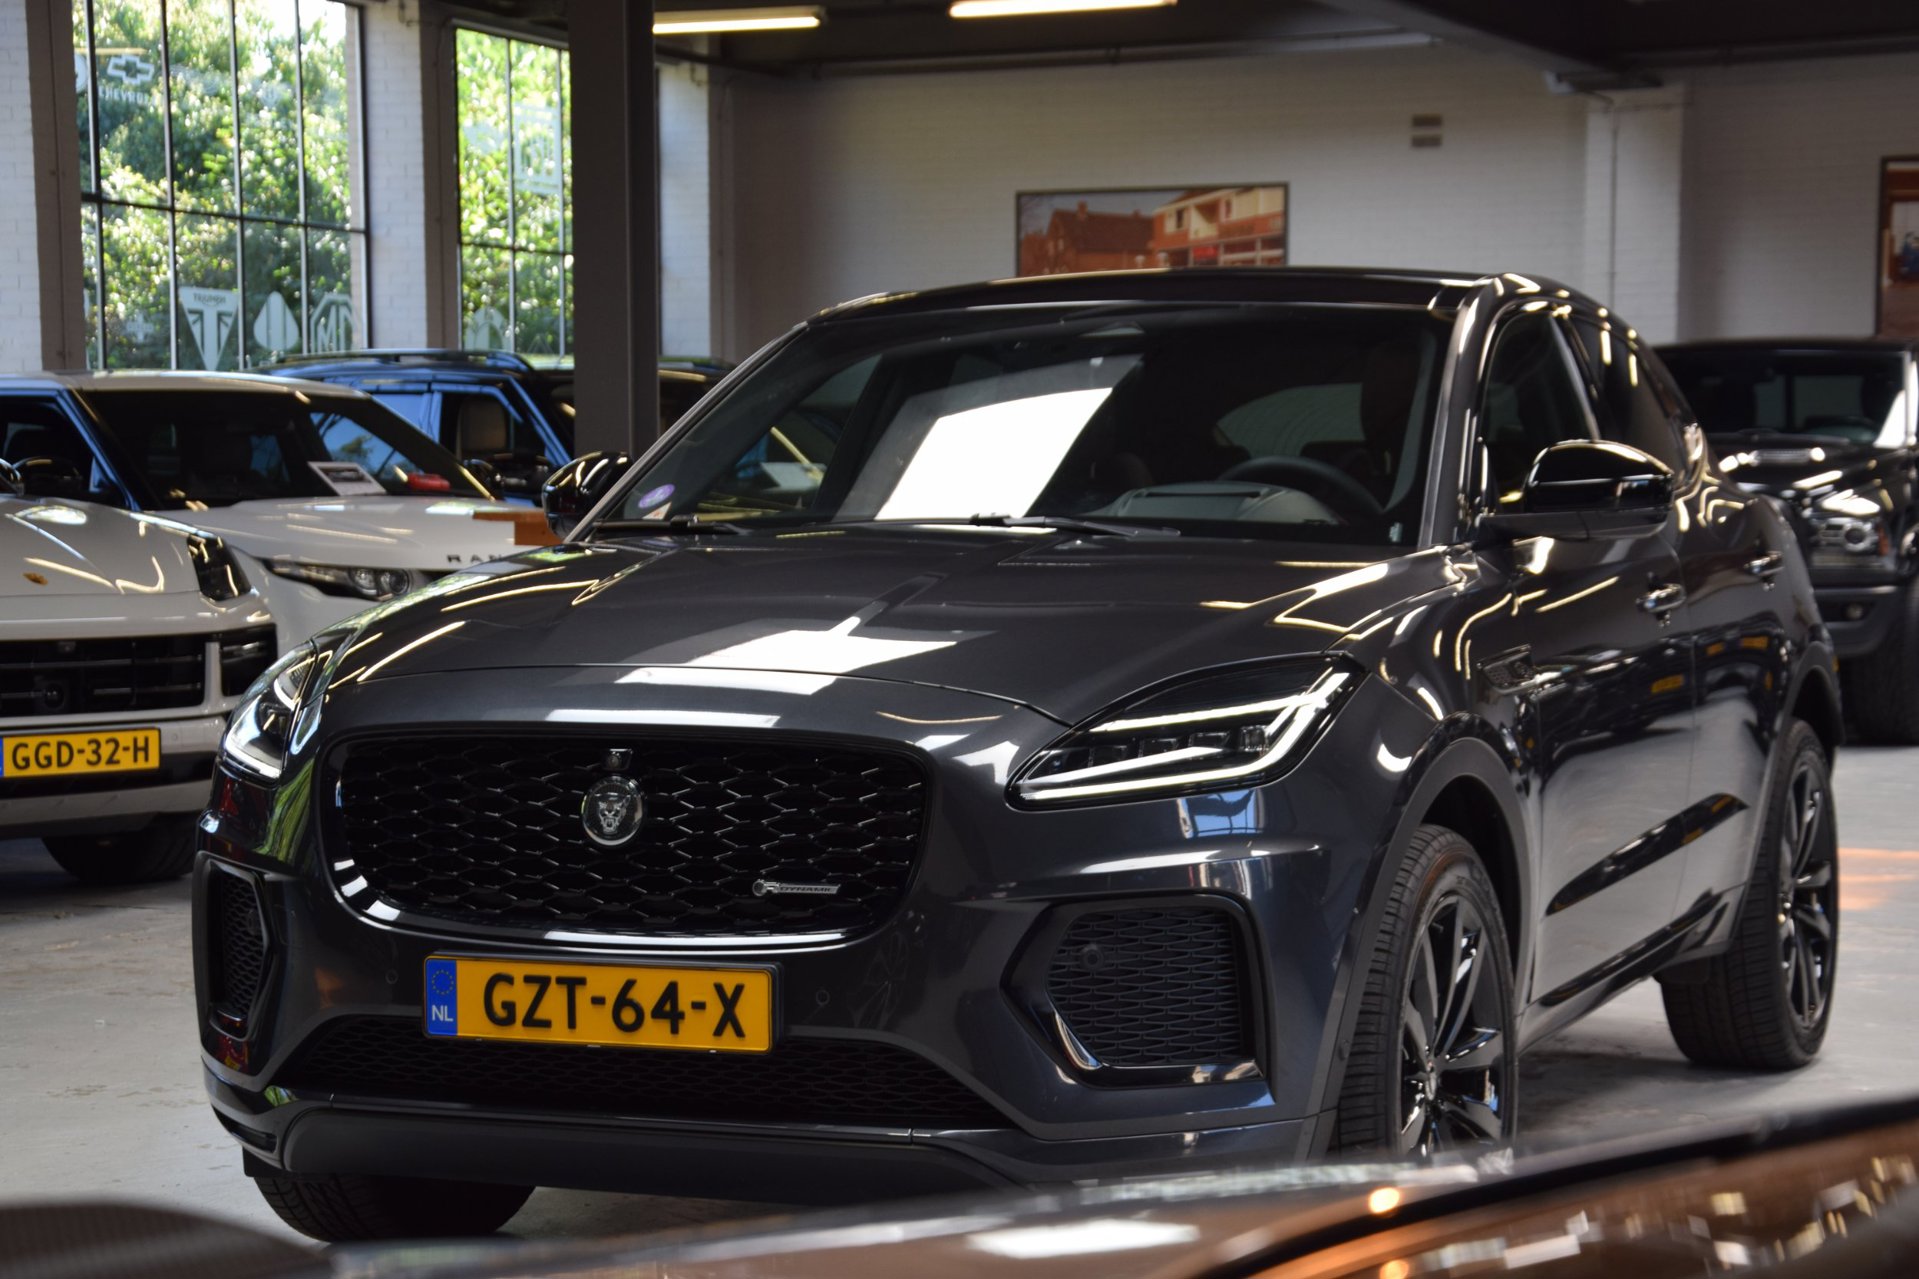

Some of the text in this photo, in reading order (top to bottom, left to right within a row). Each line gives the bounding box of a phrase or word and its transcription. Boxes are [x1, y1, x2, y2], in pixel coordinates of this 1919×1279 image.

[12, 736, 149, 770] GGD-32-H
[431, 1004, 454, 1022] NL
[483, 972, 745, 1038] GZT-64-X
